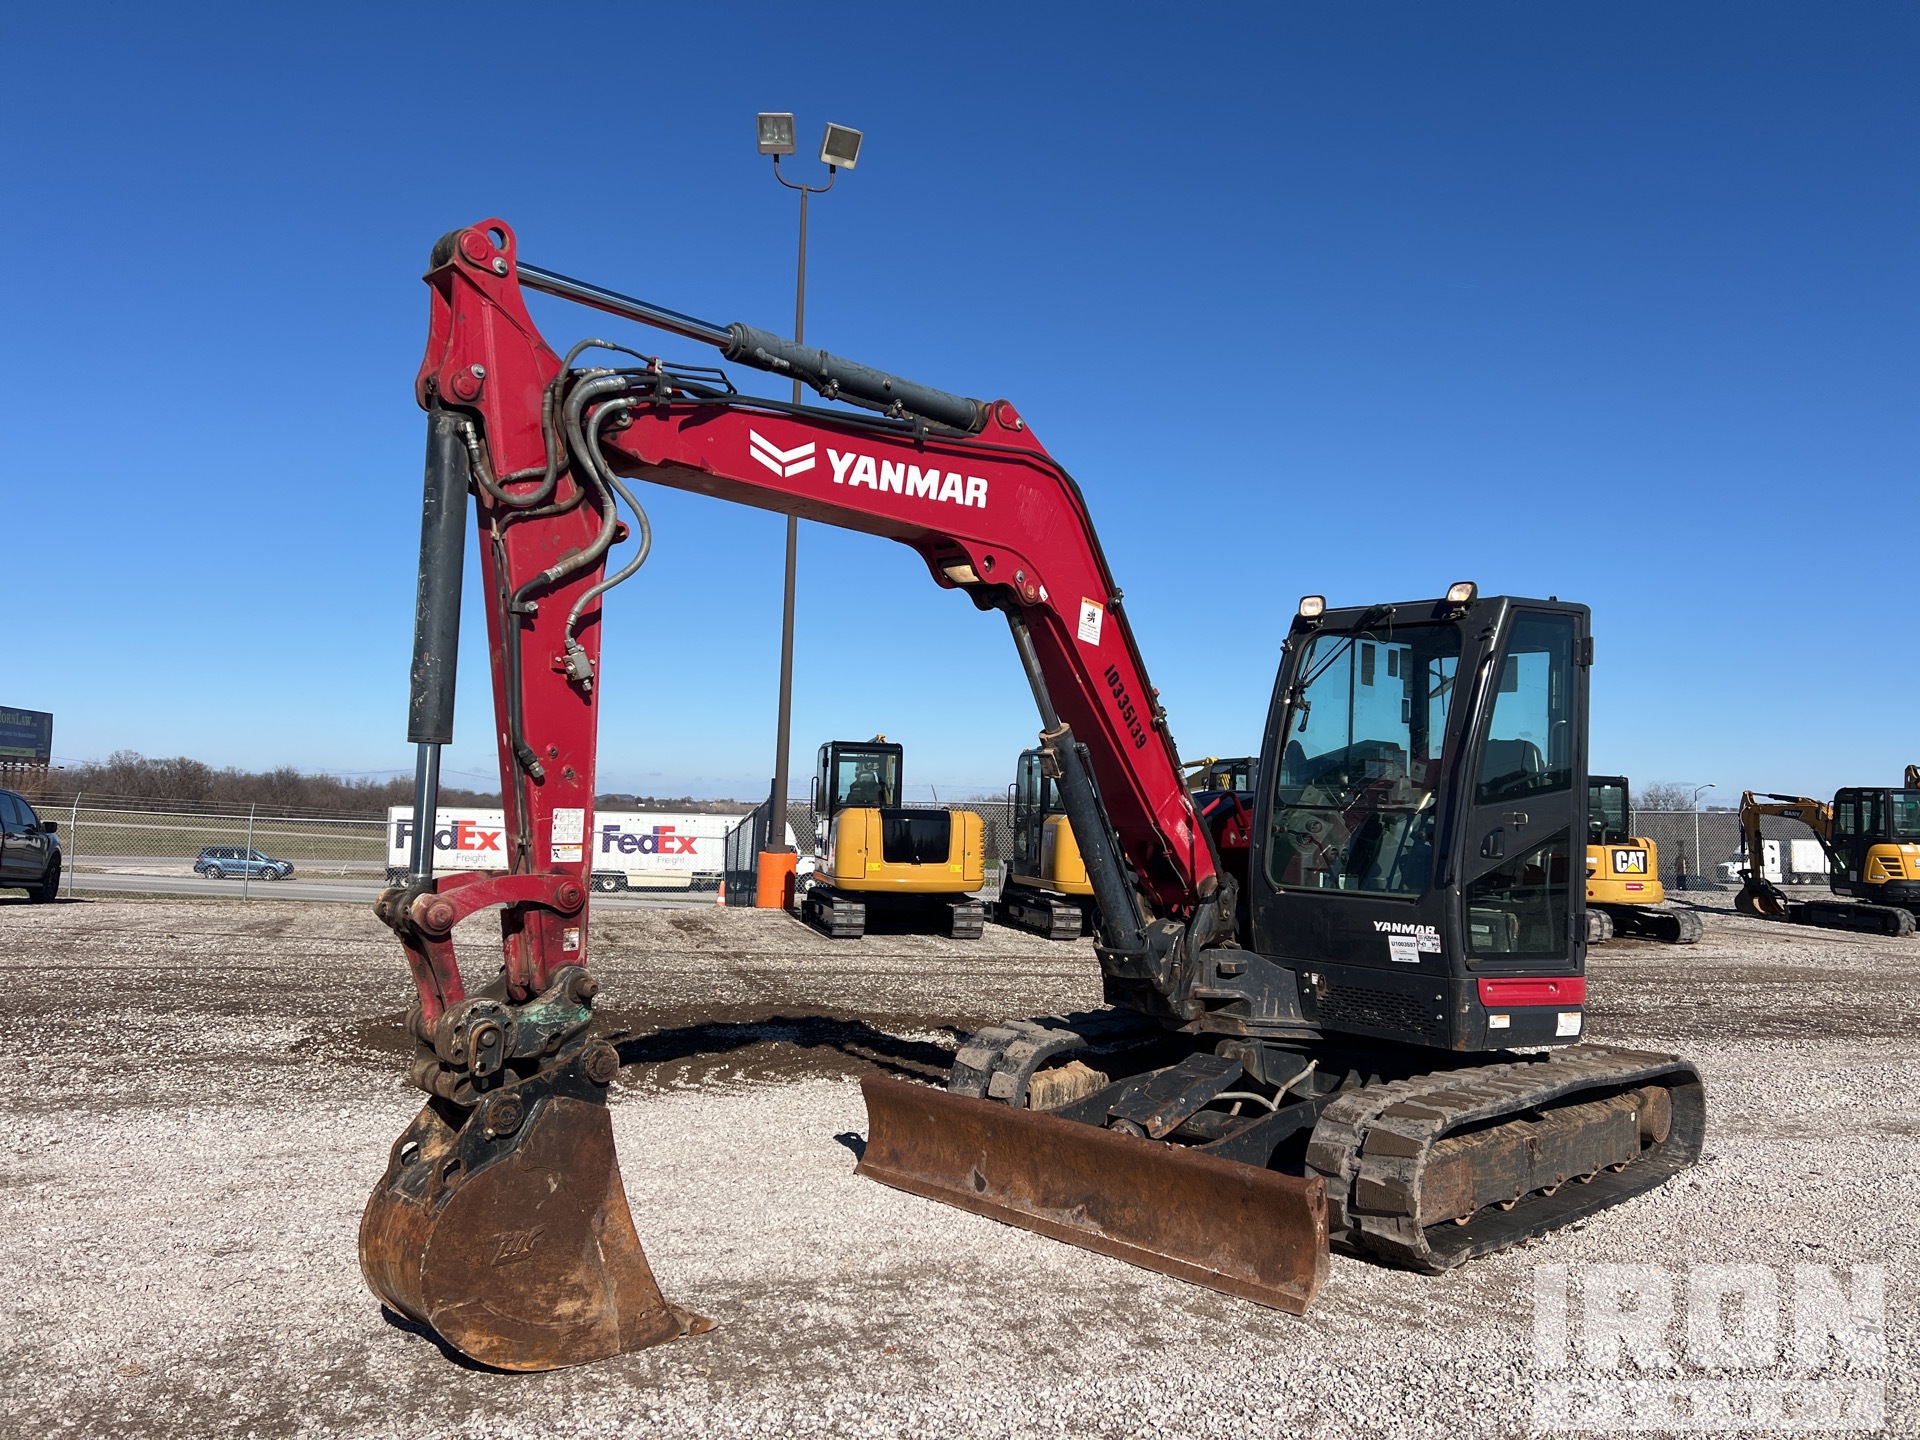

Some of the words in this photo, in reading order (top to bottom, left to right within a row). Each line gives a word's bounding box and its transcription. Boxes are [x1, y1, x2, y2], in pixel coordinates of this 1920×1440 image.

[826, 448, 989, 509] YANMAR
[1103, 664, 1147, 750] 10335139
[395, 819, 502, 851] FdEx
[602, 825, 698, 854] FedEx
[456, 852, 487, 864] Freight
[657, 855, 686, 865] Freight
[1615, 850, 1645, 873] CAT
[1373, 920, 1436, 935] YANMAR
